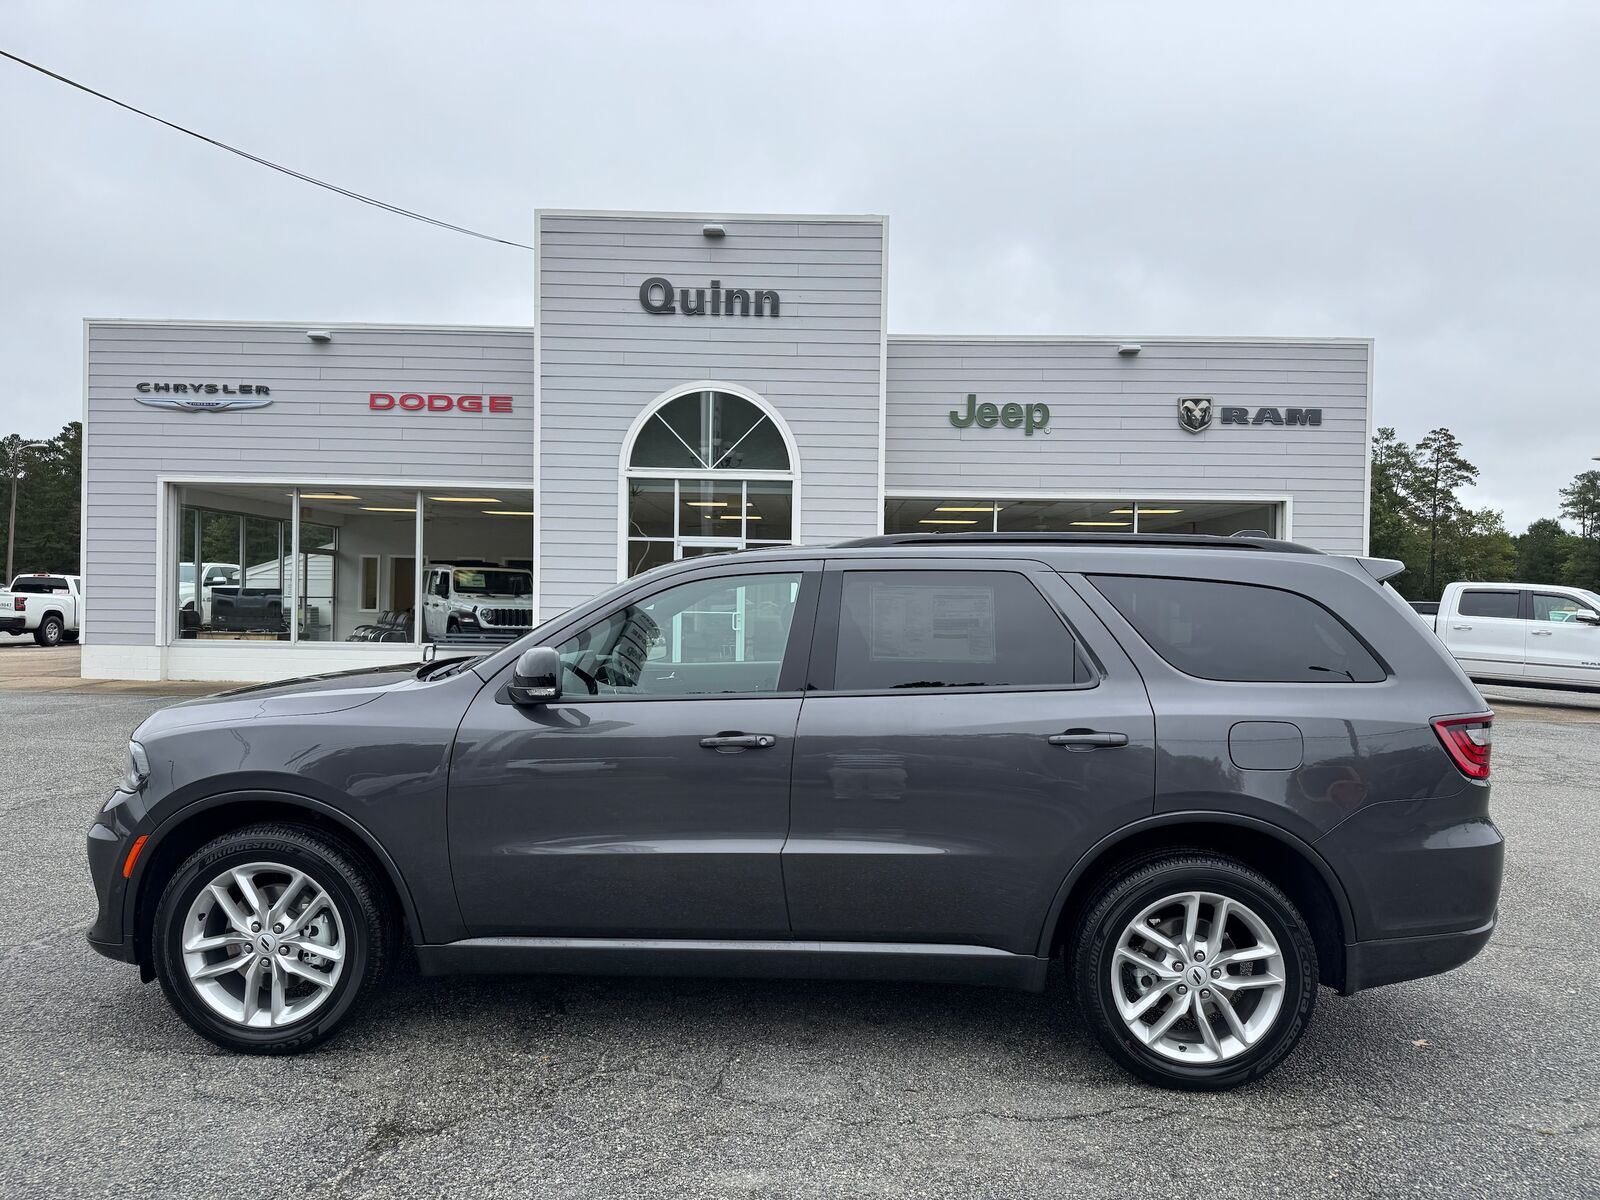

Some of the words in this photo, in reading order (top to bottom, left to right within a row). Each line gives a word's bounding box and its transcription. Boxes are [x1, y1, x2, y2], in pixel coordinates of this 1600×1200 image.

[639, 277, 780, 317] Quinn
[136, 383, 270, 395] CHRYSLER
[369, 393, 513, 413] DODGE
[949, 394, 1050, 436] Jeep
[1221, 407, 1323, 426] RAM
